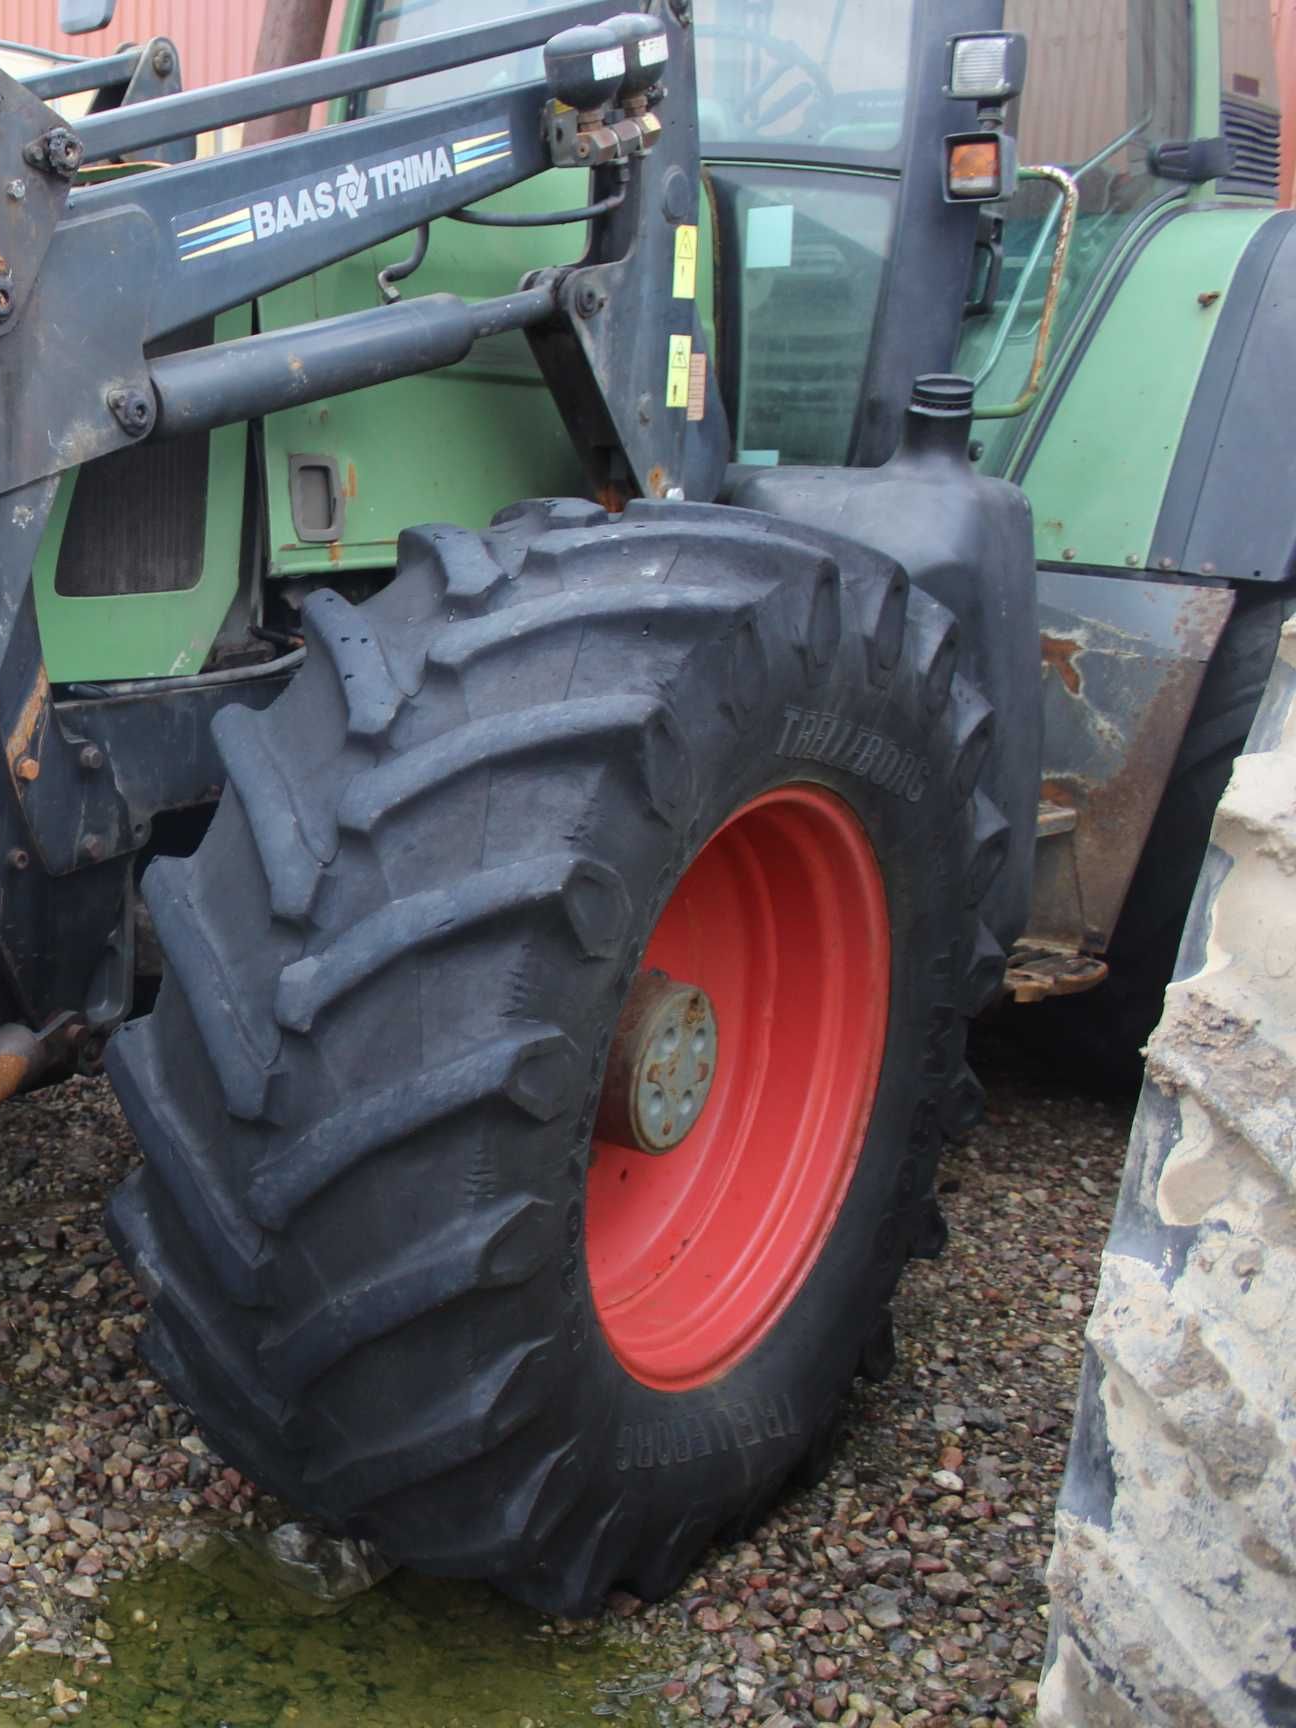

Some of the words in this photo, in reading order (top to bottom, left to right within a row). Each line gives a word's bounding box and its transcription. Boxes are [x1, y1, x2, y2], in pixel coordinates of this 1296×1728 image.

[253, 182, 337, 240] BAAS
[368, 147, 453, 200] TRIMA
[775, 704, 930, 802] TRELLEBORG
